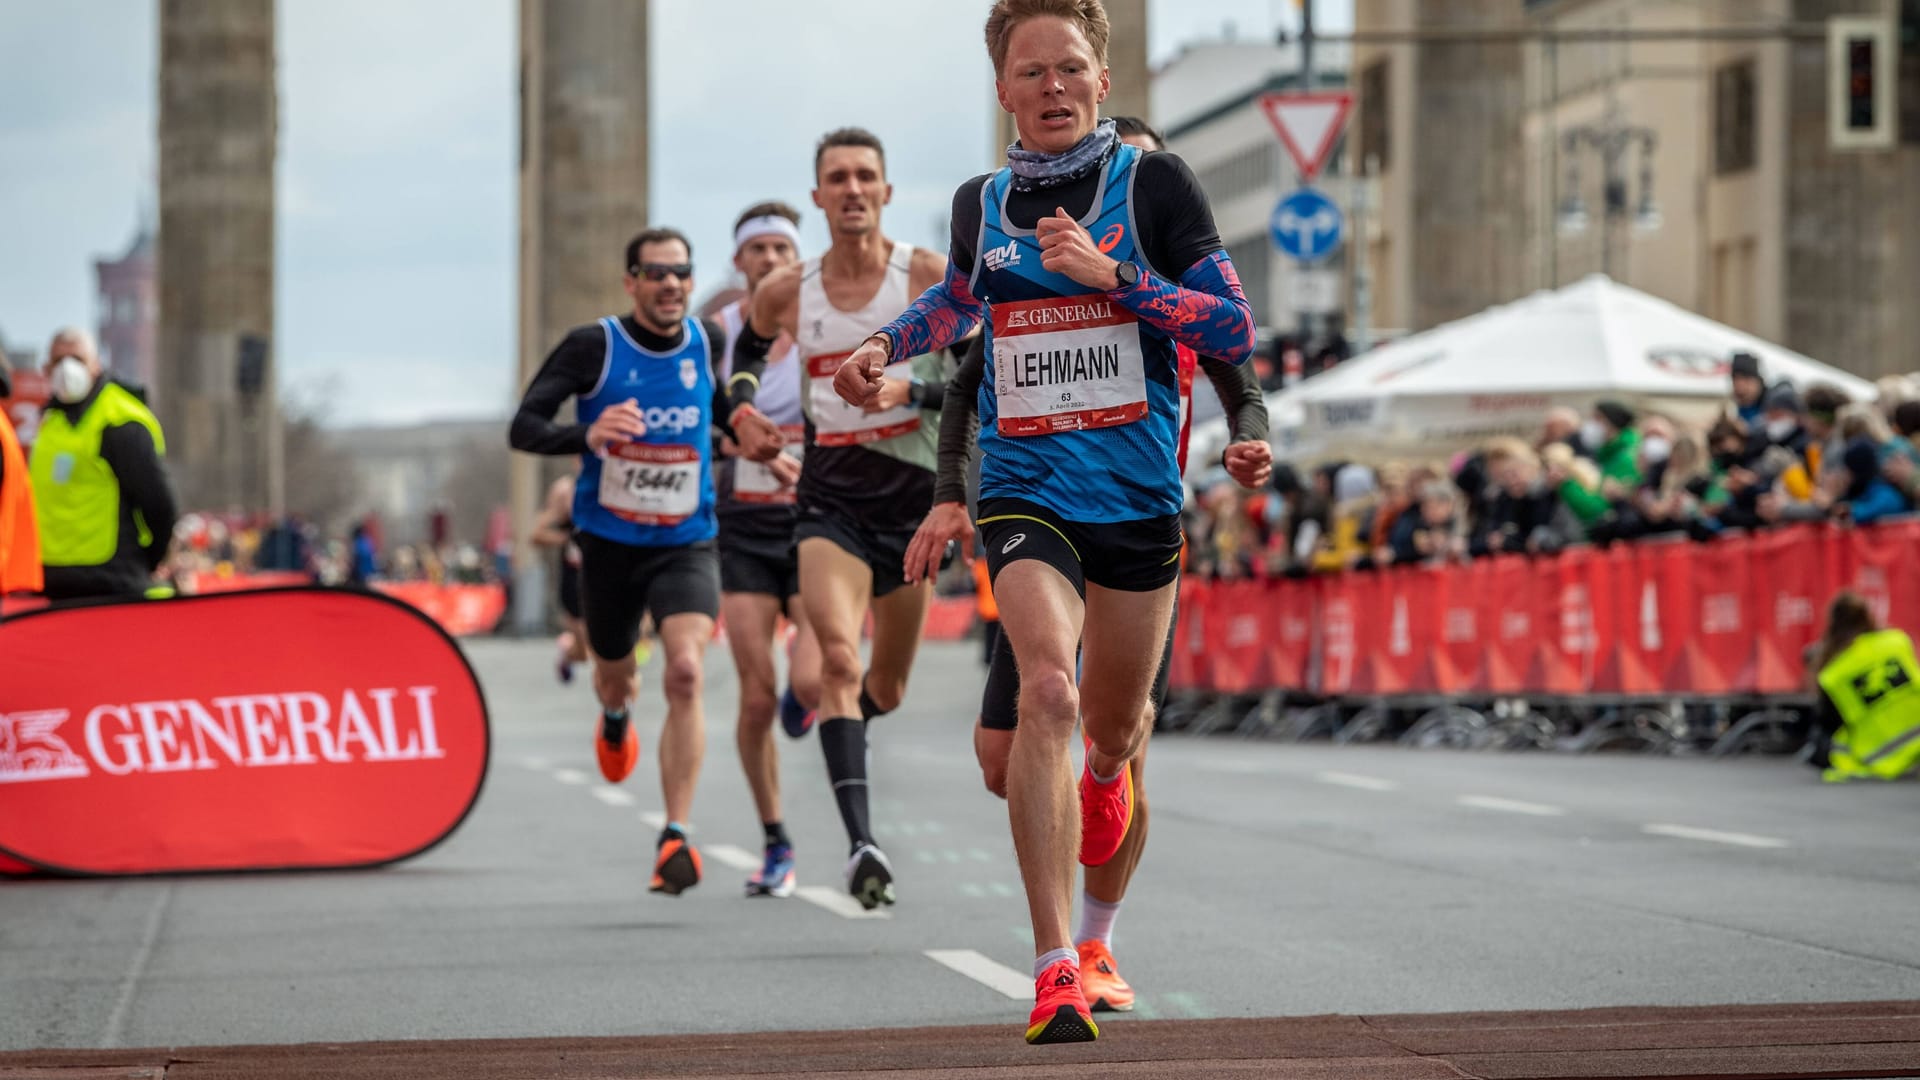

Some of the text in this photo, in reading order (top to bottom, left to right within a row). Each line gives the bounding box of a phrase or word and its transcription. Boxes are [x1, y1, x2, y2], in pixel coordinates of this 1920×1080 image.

[1029, 302, 1113, 326] GENERALI
[1014, 343, 1119, 388] LEHMANN
[1061, 392, 1071, 402] 63
[84, 686, 446, 775] GENERALI
